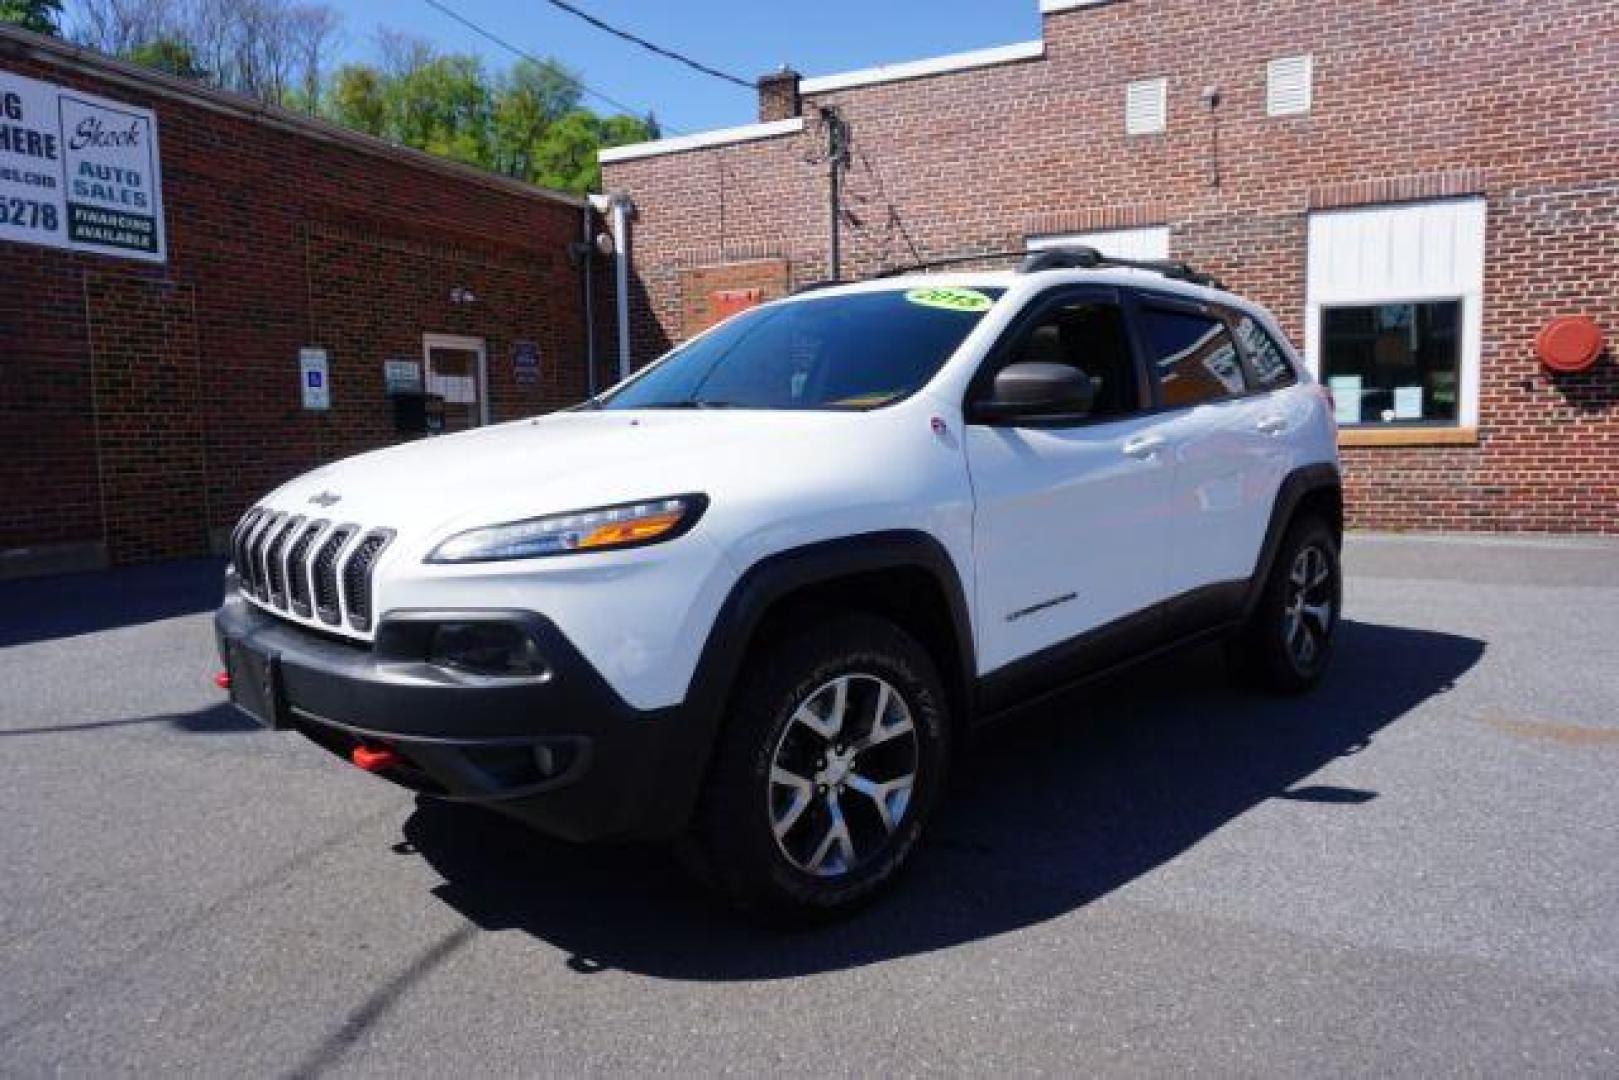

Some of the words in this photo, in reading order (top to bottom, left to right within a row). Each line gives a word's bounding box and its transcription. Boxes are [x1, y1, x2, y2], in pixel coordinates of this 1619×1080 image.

[79, 161, 141, 187] AUTO
[73, 179, 147, 207] SALES
[0, 195, 58, 231] 5278
[75, 208, 151, 232] FINANCING
[75, 225, 150, 248] AVAILABLE
